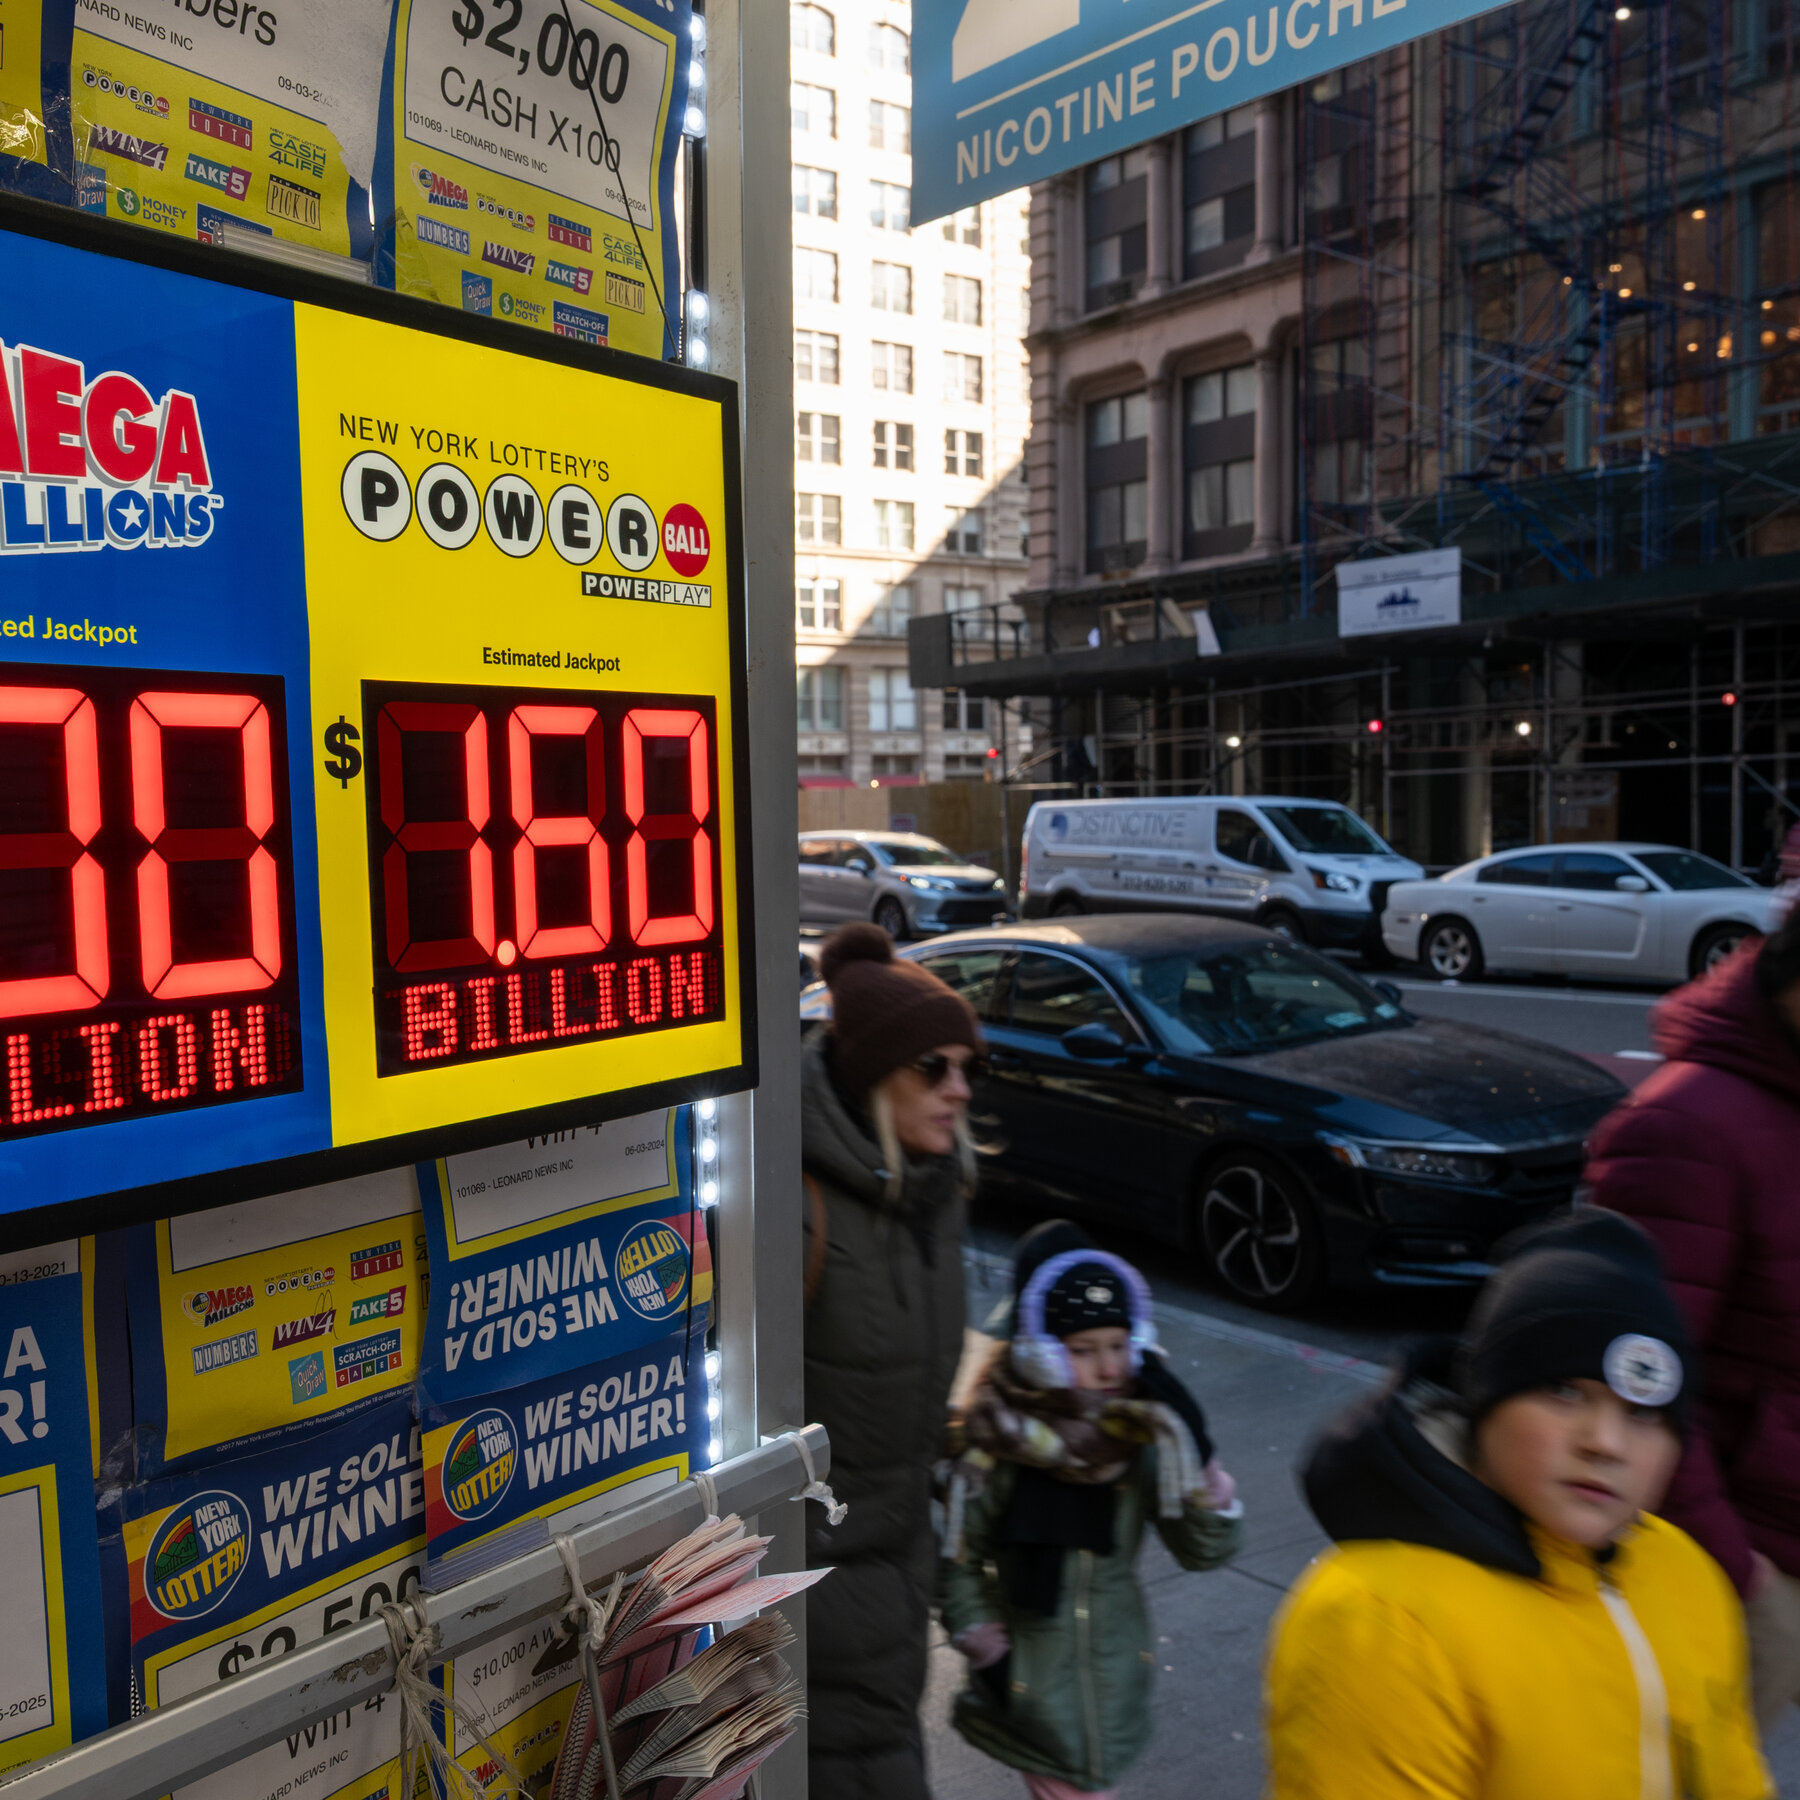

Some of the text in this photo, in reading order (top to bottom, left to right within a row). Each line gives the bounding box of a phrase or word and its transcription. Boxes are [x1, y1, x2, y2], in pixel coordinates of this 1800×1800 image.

[124, 13, 166, 40] NEWS
[170, 31, 193, 51] INC
[174, 0, 278, 46] bers
[452, 0, 630, 104] $2,000
[277, 75, 340, 108] 09-03-2
[191, 99, 250, 128] NEW YORK
[440, 66, 621, 173] CASH X100
[956, 59, 1156, 185] NICOTINE
[191, 114, 250, 147] LOTTO
[407, 110, 548, 174] 101069 LEONARD NEWS INC
[268, 150, 326, 179] 4LIFE
[269, 132, 327, 165] CASH
[79, 190, 105, 207] Draw
[270, 184, 300, 219] PICK
[428, 193, 469, 211] MILLIONS
[431, 171, 469, 202] MEGA
[142, 196, 187, 219] MONEY
[142, 209, 177, 228] DOTS
[418, 218, 468, 252] NUMBERS
[550, 226, 591, 251] LOTTO
[603, 236, 644, 260] CASH
[604, 250, 644, 271] 4LIFE
[467, 282, 486, 299] Quick
[474, 296, 492, 311] Draw
[608, 278, 630, 306] PICK
[515, 299, 546, 315] MONEY
[515, 308, 538, 323] DOTS
[556, 311, 605, 332] SCRATCH-OFF
[339, 413, 610, 482] NEW YORK LOTTERY'S
[1, 482, 211, 545] LLIONS
[42, 617, 138, 647] Jackpot
[482, 646, 621, 673] Estimated Jackpot
[405, 951, 704, 1061] BILLION
[3, 1003, 268, 1125] LION
[625, 1138, 666, 1157] 06-03-2024
[456, 1159, 574, 1199] 101069 LEONARD NEWS INC
[352, 1253, 402, 1278] LOTTO
[619, 1228, 682, 1281] LOTTERY
[206, 1284, 254, 1315] MEGA
[446, 1237, 609, 1330] WINNER!
[624, 1268, 660, 1299] YORK
[204, 1299, 254, 1328] MILLIONS
[639, 1297, 666, 1312] NEW
[444, 1287, 619, 1373] WE SOLD A
[3, 1325, 47, 1378] A
[194, 1333, 257, 1372] NUMBERS
[338, 1339, 397, 1366] SCRATCH-OFF
[297, 1358, 318, 1388] Quick
[306, 1368, 325, 1397] Draw
[524, 1354, 685, 1440] WE SOLD A
[476, 1415, 504, 1439] NEW
[523, 1393, 687, 1490] WINNER!
[479, 1434, 511, 1465] YORK
[262, 1466, 332, 1523] WE
[450, 1448, 515, 1513] LOTTERY
[195, 1501, 231, 1528] NEW
[260, 1468, 425, 1579] WINNE
[199, 1513, 242, 1554] YORK
[156, 1535, 246, 1612] LOTTERY
[472, 1642, 525, 1687] $10,000
[492, 1684, 531, 1717] LEONARD
[532, 1668, 557, 1689] NEWS
[0, 1758, 33, 1774] OTTERY
[294, 1750, 349, 1788] NEWS INC
